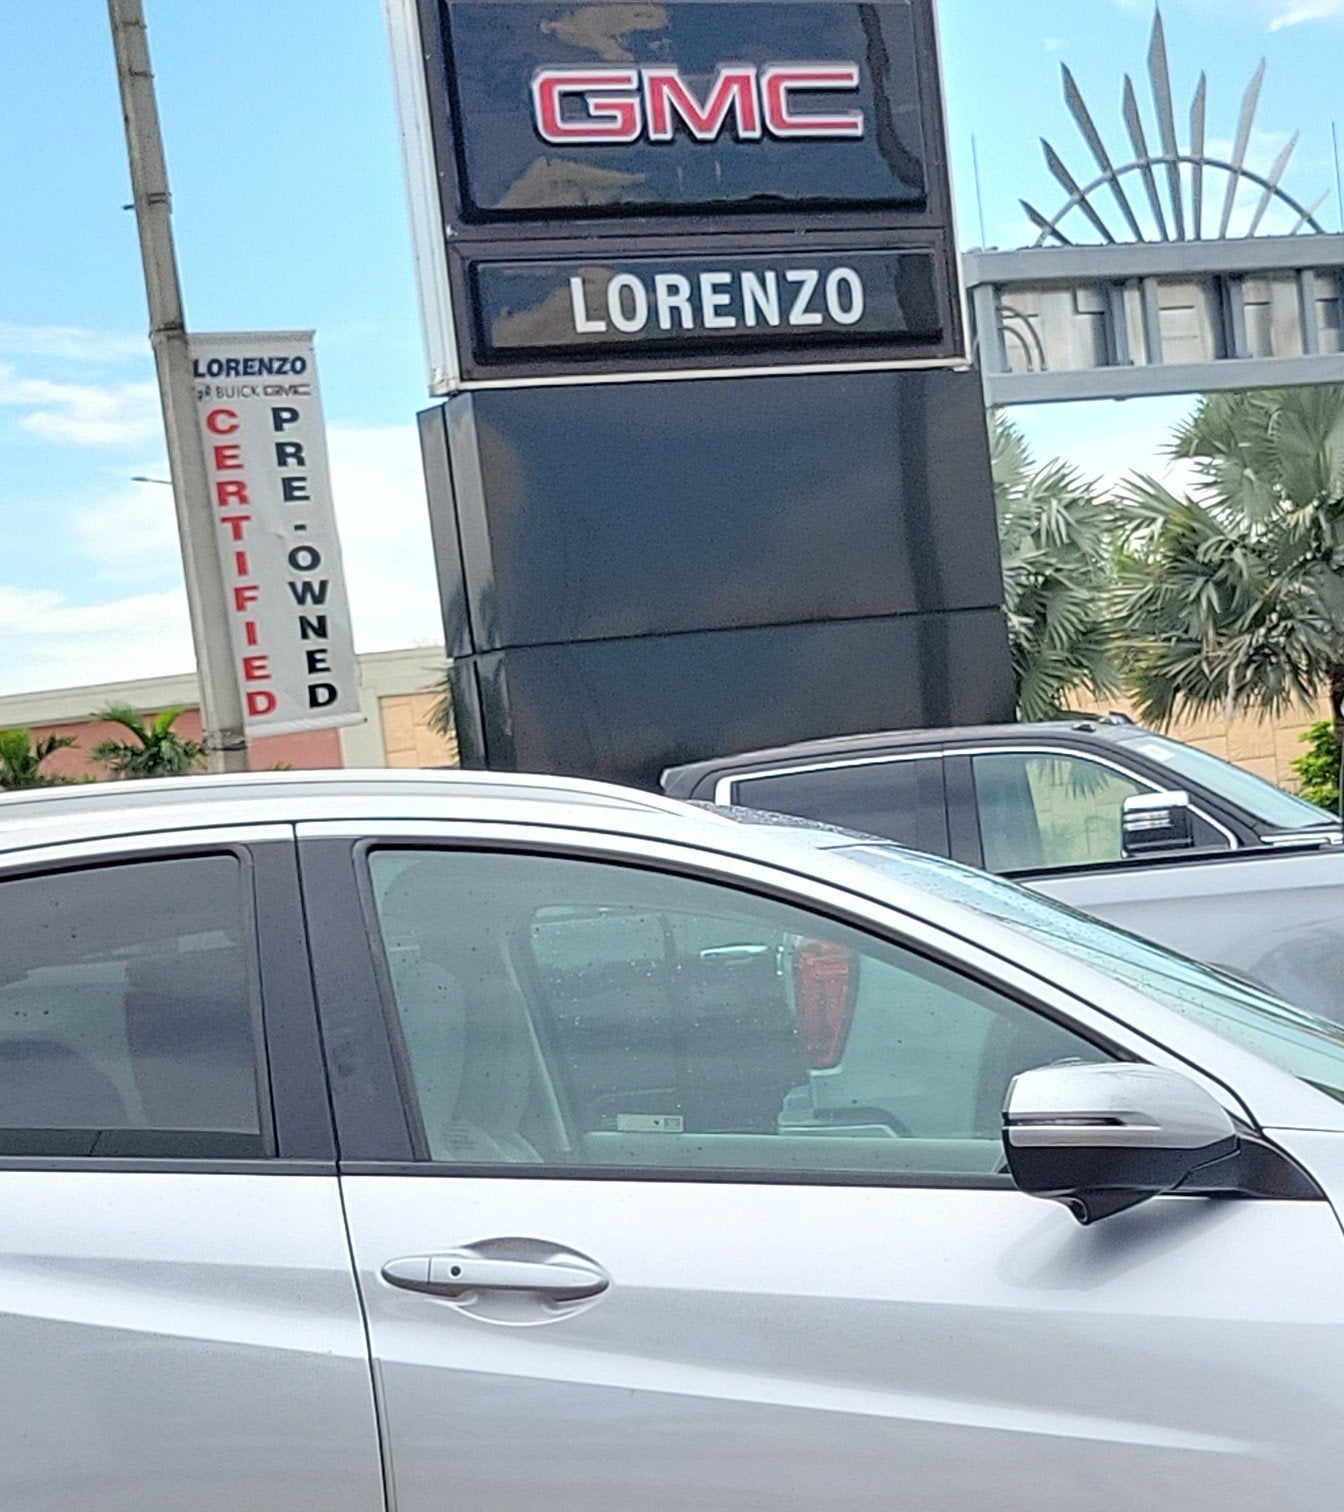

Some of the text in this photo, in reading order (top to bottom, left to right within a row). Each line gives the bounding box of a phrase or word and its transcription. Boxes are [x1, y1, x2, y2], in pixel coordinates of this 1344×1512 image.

[532, 66, 864, 145] GMC
[569, 266, 865, 333] LORENZO
[193, 356, 307, 377] LORENZO
[206, 408, 277, 717] CERTIFIED
[271, 407, 339, 709] PRE-OWNED
